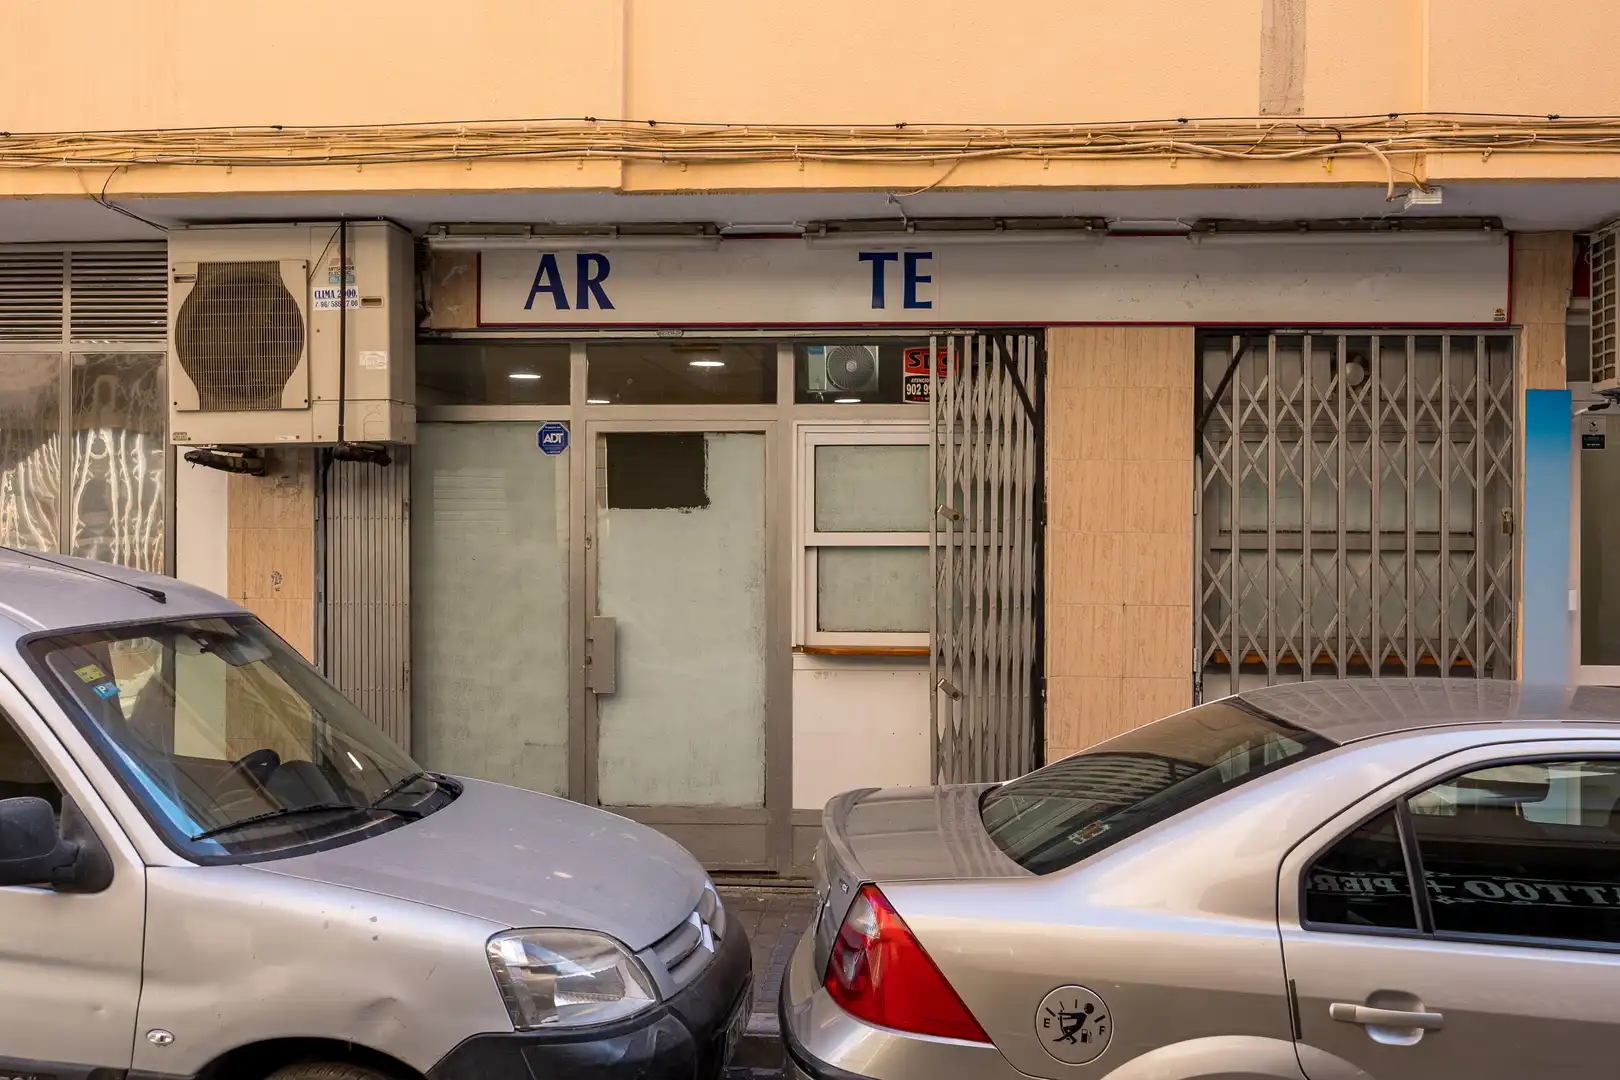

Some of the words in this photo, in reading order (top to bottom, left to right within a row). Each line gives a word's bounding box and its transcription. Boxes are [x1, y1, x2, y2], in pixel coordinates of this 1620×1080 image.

[523, 253, 616, 310] AR
[858, 251, 933, 309] TE
[314, 289, 335, 299] CLIMA
[906, 383, 922, 395] 902
[543, 432, 564, 444] ADT
[1043, 1018, 1051, 1028] E
[1099, 1025, 1106, 1036] F
